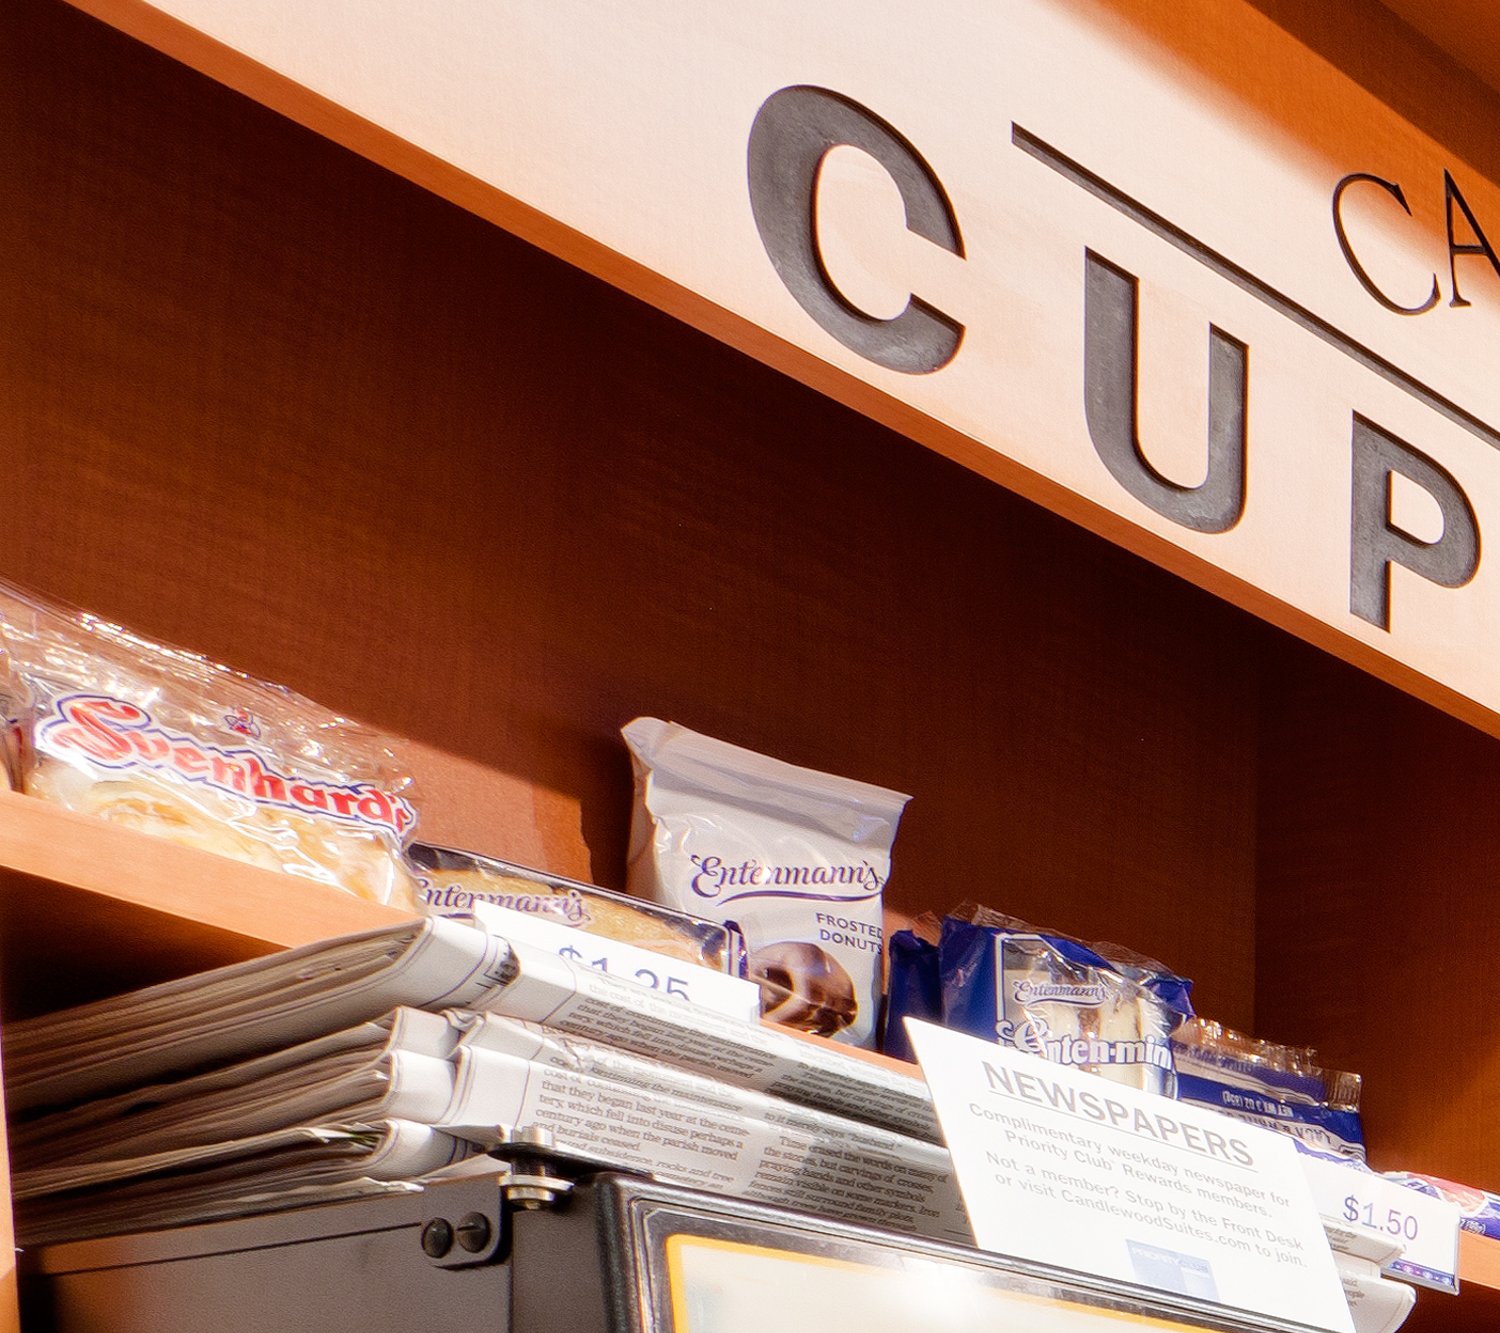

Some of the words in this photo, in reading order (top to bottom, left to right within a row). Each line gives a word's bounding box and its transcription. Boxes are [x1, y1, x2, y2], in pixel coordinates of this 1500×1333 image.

[691, 853, 885, 896] Entenmann's
[969, 1103, 1101, 1154] Complimentary
[1110, 1139, 1179, 1177] weekday
[1184, 1164, 1266, 1201] newspaper
[1270, 1187, 1290, 1207] for
[982, 1060, 1255, 1166] NEWSPAPERS
[986, 1151, 1019, 1174] Not
[1024, 1165, 1036, 1176] a
[1041, 1165, 1119, 1197] member?
[1125, 1190, 1164, 1216] Stop
[1169, 1201, 1187, 1225] by
[1191, 1207, 1217, 1228] the
[1221, 1216, 1261, 1242] Front
[1266, 1226, 1305, 1252] Desk
[995, 1174, 1013, 1186] or
[1018, 1178, 1055, 1201] visit
[1060, 1188, 1251, 1254] CandlewoodSuites.com
[1254, 1244, 1272, 1259] to
[1005, 1130, 1068, 1161] Priority
[1123, 1165, 1192, 1195] Rewards
[1197, 1187, 1272, 1218] members.
[1343, 1195, 1418, 1240] $1.50
